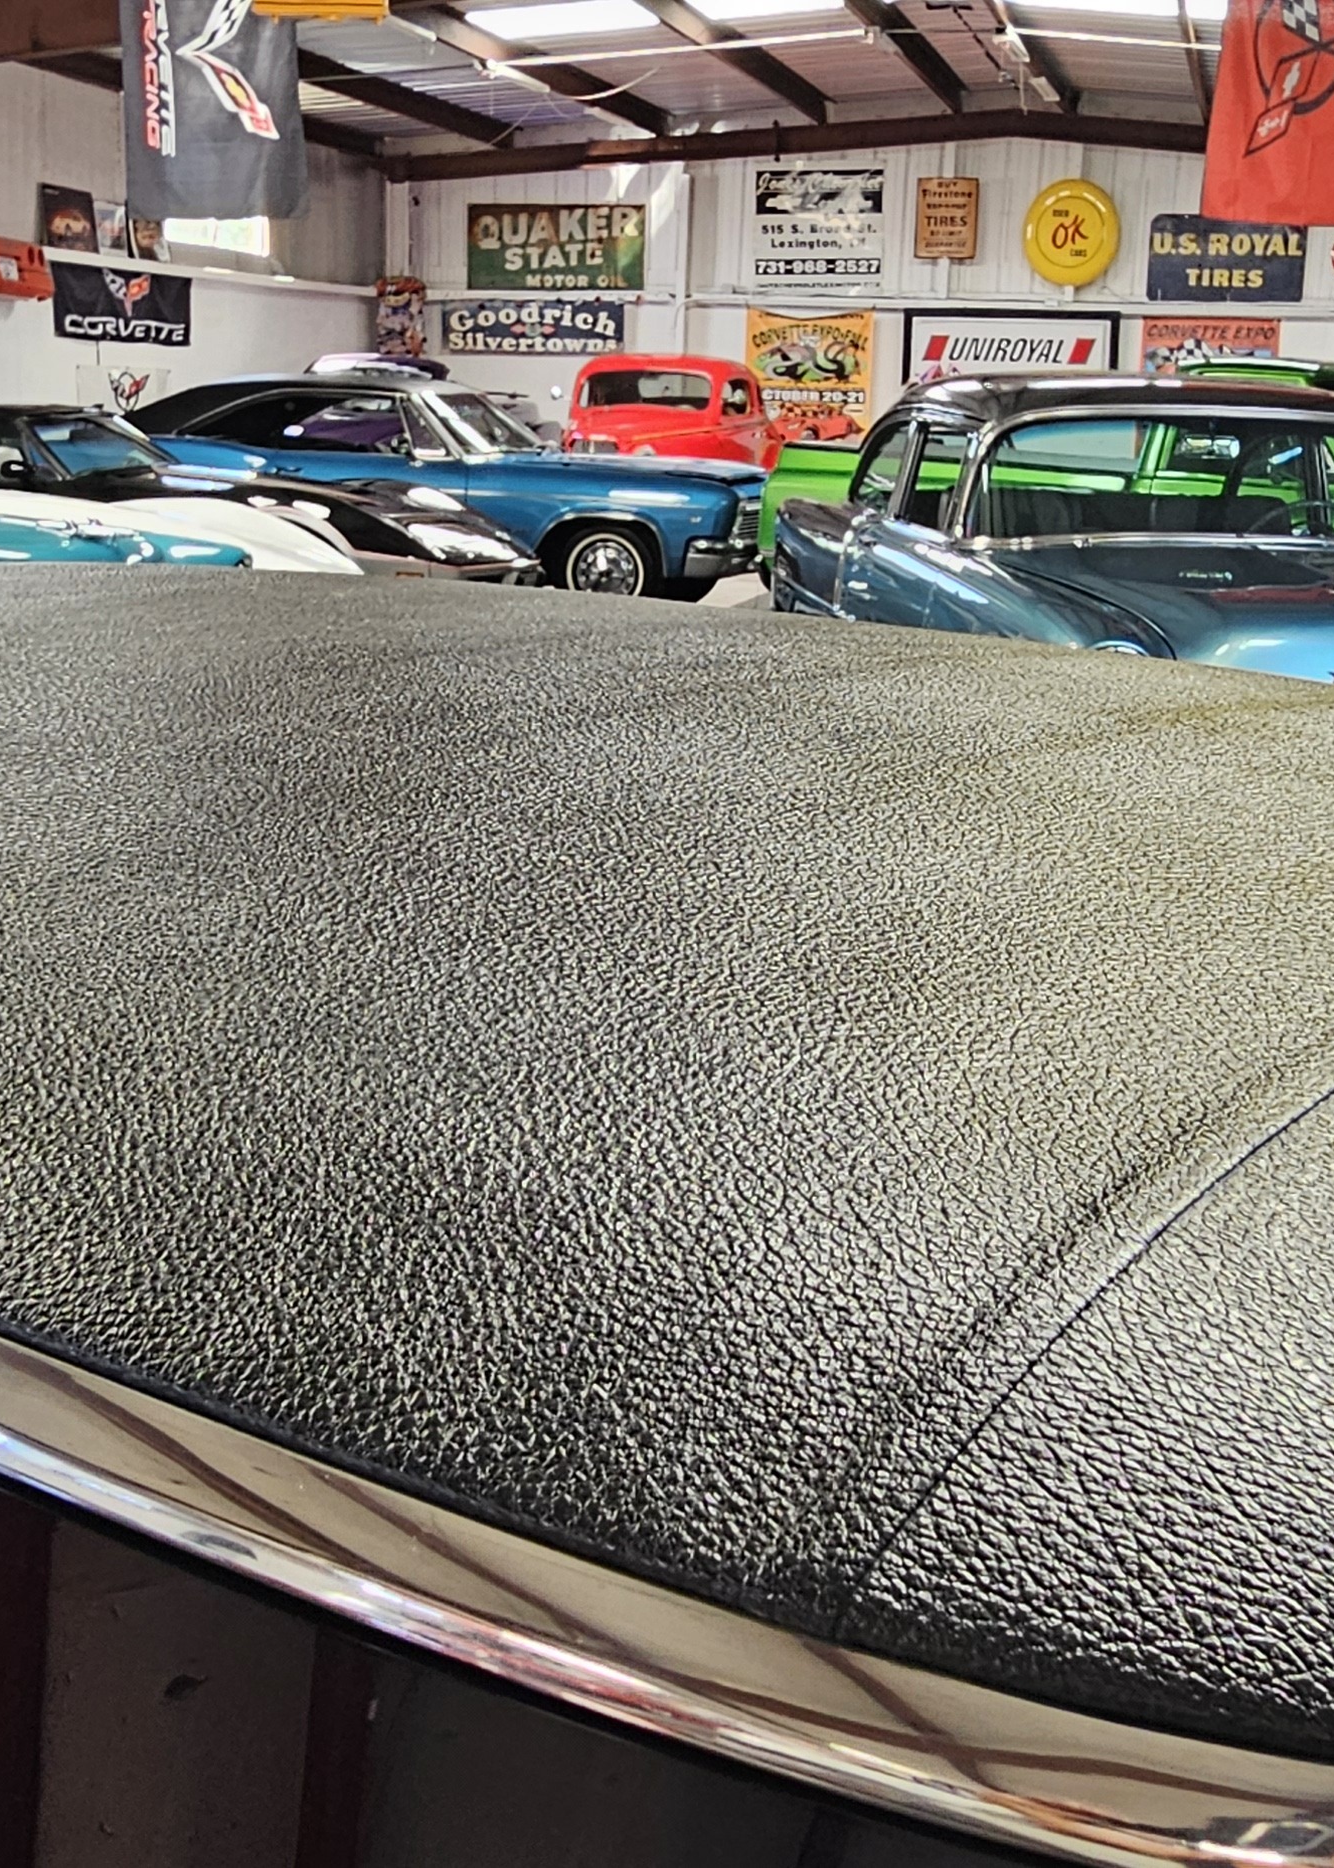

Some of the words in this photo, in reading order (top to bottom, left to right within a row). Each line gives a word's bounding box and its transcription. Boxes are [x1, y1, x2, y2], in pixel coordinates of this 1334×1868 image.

[142, 0, 161, 149] RACING
[478, 207, 640, 249] QUAKER
[761, 224, 784, 234] 515
[924, 216, 968, 227] TIRES
[1051, 214, 1089, 249] OK
[771, 239, 842, 250] Lexington,
[1152, 232, 1202, 256] U.S.
[1207, 233, 1303, 256] ROYAL
[504, 242, 604, 271] STATE
[526, 275, 589, 288] MOTOR
[597, 275, 628, 288] OIL
[1186, 268, 1264, 288] TIRES
[64, 314, 186, 342] CORVETTE
[449, 301, 615, 336] Goodrich
[449, 332, 617, 353] Silvertowns
[1147, 324, 1231, 340] CORVETTE
[1233, 326, 1275, 341] EXPO
[948, 337, 1065, 364] UNIROYAL
[761, 388, 820, 401] CTOBER
[822, 390, 864, 403] 20-21
